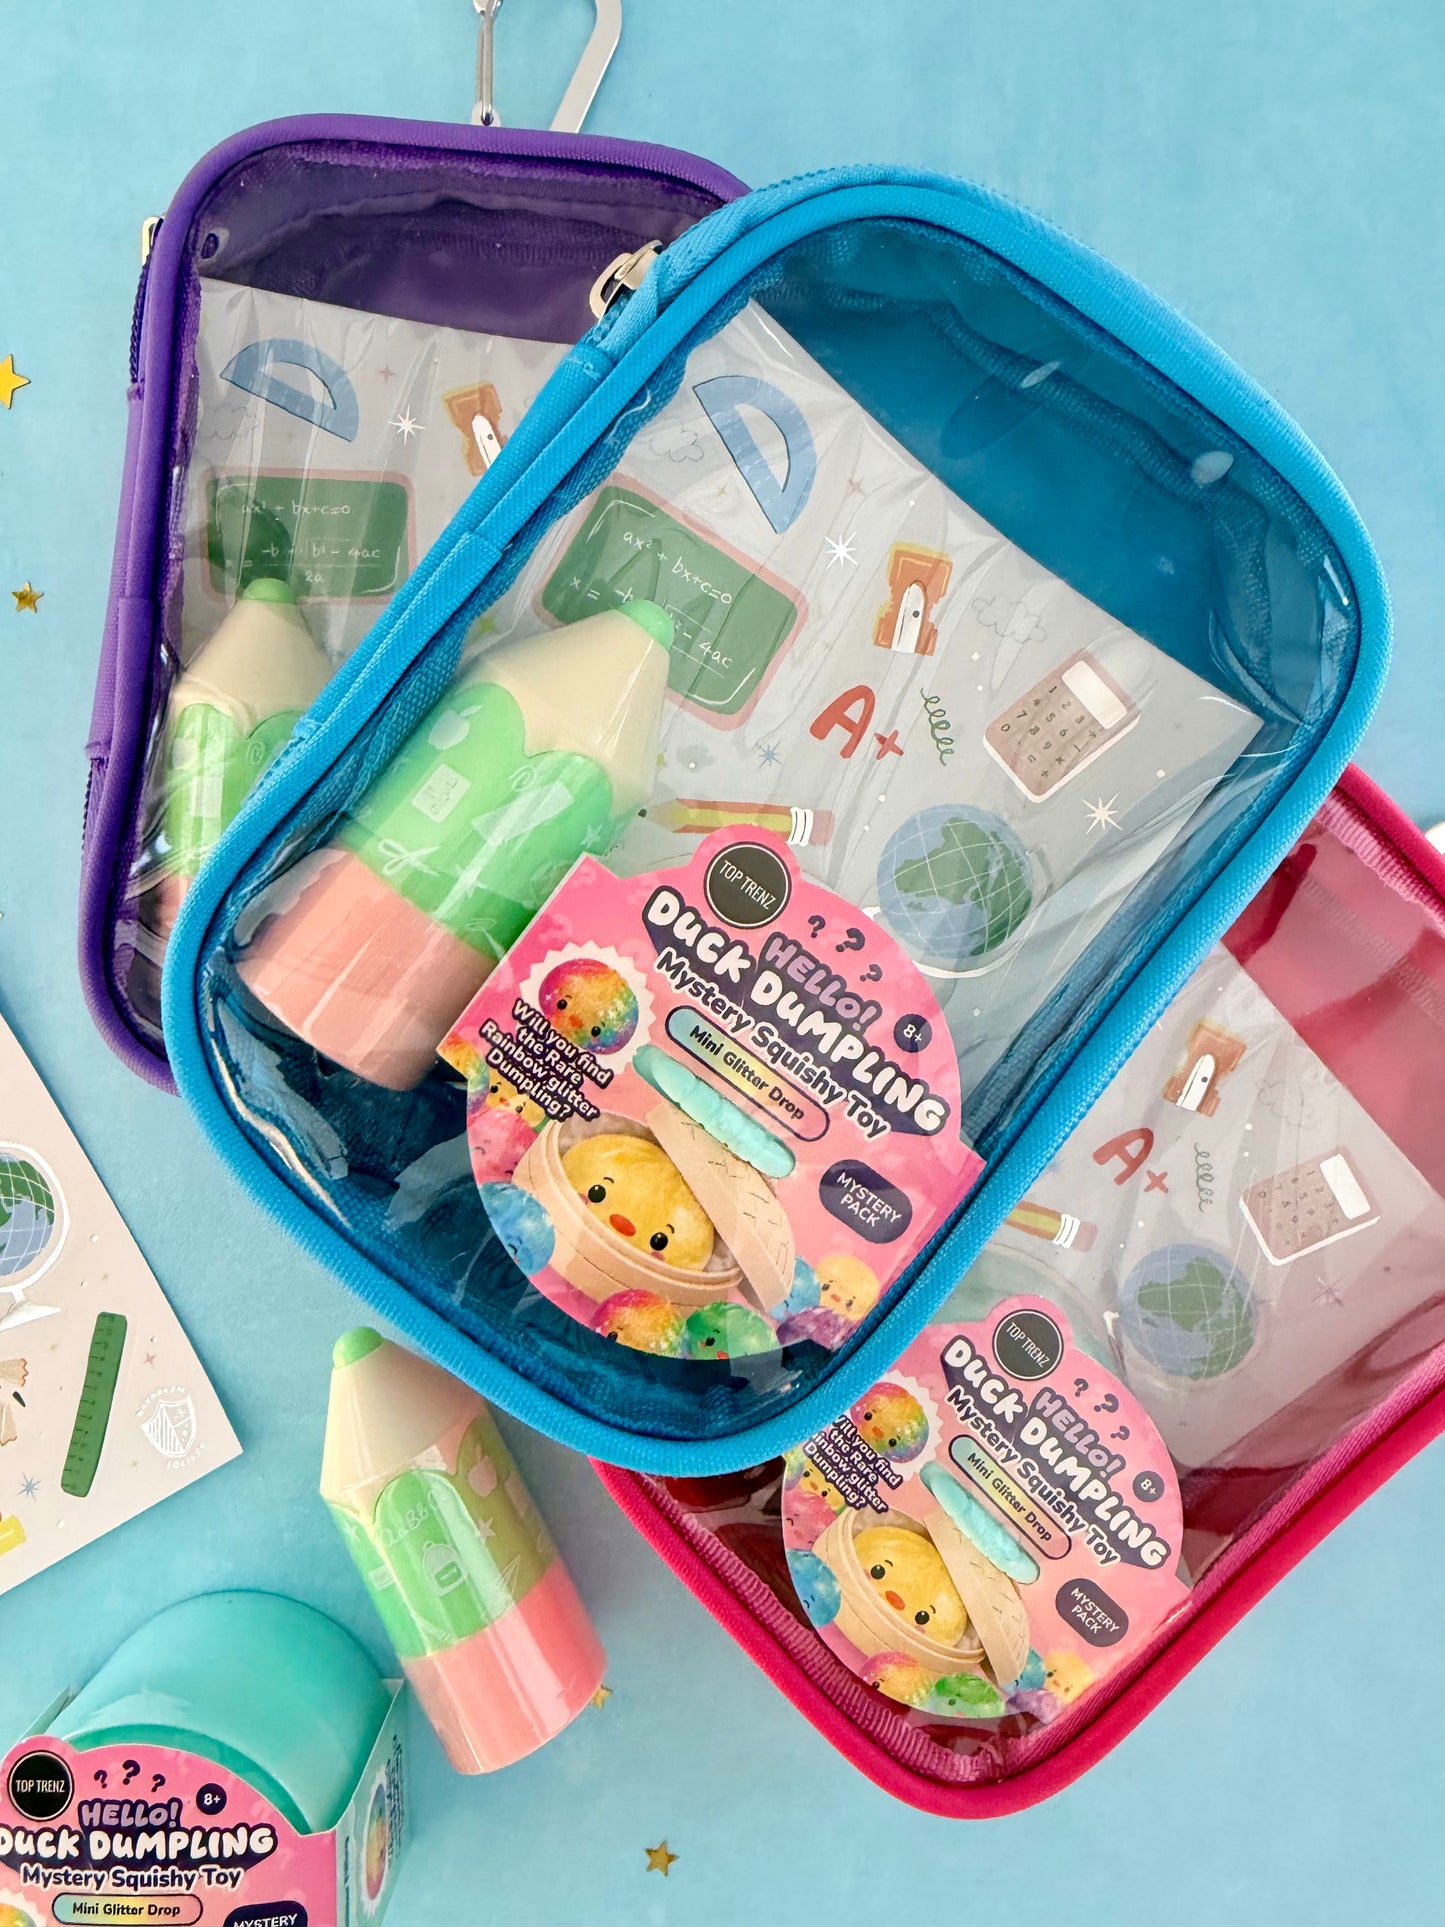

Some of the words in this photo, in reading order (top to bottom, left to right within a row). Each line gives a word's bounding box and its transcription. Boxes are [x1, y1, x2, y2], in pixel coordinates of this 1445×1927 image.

[809, 684, 905, 760] A+
[719, 860, 744, 888] TOP
[740, 877, 777, 911] TRENZ
[647, 889, 751, 984] DUCK
[750, 969, 947, 1132] DUMPLING
[764, 936, 879, 1032] HELLO!
[513, 999, 549, 1036] Will
[545, 1029, 577, 1059] you
[577, 1053, 612, 1084] find
[517, 1028, 544, 1055] the
[545, 1049, 582, 1085] Rare
[655, 949, 752, 1035] Mystery
[750, 1022, 844, 1106] Squishy
[847, 1092, 890, 1139] Toy
[902, 1023, 922, 1043] 8+
[481, 1021, 548, 1078] Rainbow
[547, 1075, 598, 1117] glitter
[487, 1047, 572, 1117] Dumpling?
[689, 1024, 725, 1057] Mini
[722, 1049, 770, 1092] Glitter
[768, 1085, 804, 1121] Drop
[836, 1170, 902, 1224] MYSTERY
[840, 1192, 880, 1228] PACK
[1006, 1321, 1027, 1344] TOP
[1021, 1338, 1050, 1368] TRENZ
[830, 1430, 850, 1453] the
[849, 1450, 878, 1482] Rare
[851, 1436, 876, 1461] you
[875, 1458, 901, 1486] find
[944, 1338, 1024, 1424] DUCK
[1019, 1416, 1168, 1566] DUMPLING
[1034, 1390, 1123, 1479] HELLO!
[804, 1441, 866, 1507] Dumpling?
[812, 1432, 851, 1472] inbow
[848, 1472, 887, 1510] glitter
[946, 1387, 1020, 1464] Mystery
[1016, 1459, 1086, 1533] Squishy
[1085, 1527, 1119, 1565] Toy
[967, 1452, 993, 1480] Mini
[991, 1477, 1027, 1515] Glitter
[1024, 1511, 1052, 1542] Drop
[1139, 1478, 1157, 1495] 8+
[1070, 1587, 1120, 1633] MYSTERY
[1071, 1604, 1102, 1634] PACK
[15, 1779, 34, 1793] TOP
[36, 1779, 66, 1794] TRENZ
[203, 1792, 221, 1806] 8+
[80, 1801, 180, 1829] HELLO!
[0, 1827, 81, 1861] DUCK
[88, 1826, 275, 1861] DUMPLING
[22, 1865, 106, 1890] Mystery
[111, 1868, 196, 1892] Squishy
[202, 1867, 242, 1887] Toy
[72, 1901, 99, 1916] Mini
[103, 1902, 144, 1917] Glitter
[147, 1902, 181, 1918] Drop
[233, 1912, 298, 1927] MYSTERY
